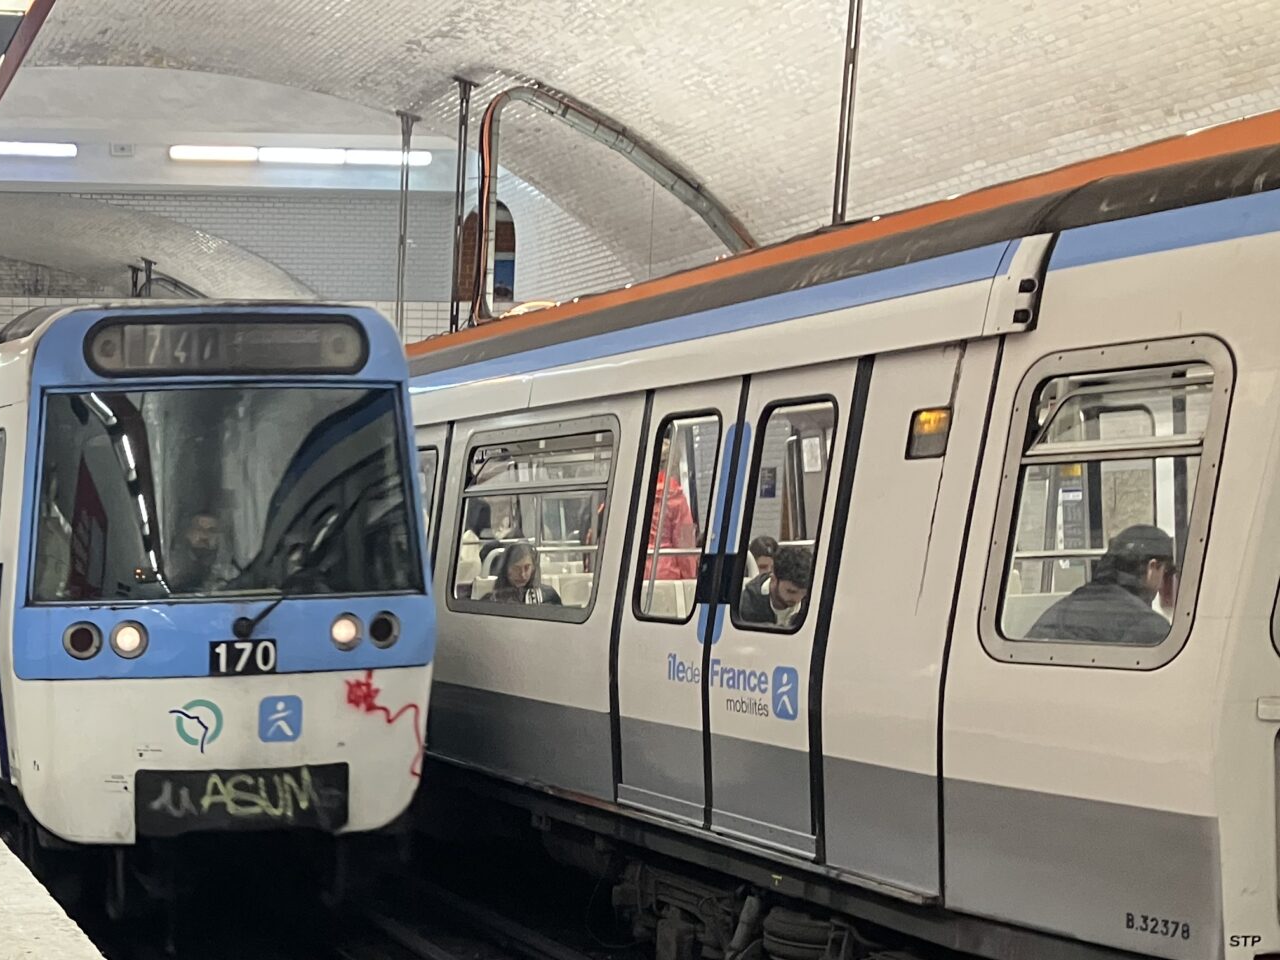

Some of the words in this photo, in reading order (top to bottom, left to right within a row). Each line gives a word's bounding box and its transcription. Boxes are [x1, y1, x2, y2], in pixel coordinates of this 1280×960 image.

[215, 641, 276, 673] 170
[710, 658, 769, 694] France
[726, 697, 769, 717] mobilités
[1125, 912, 1191, 941] B.32378
[1229, 935, 1262, 947] STP
